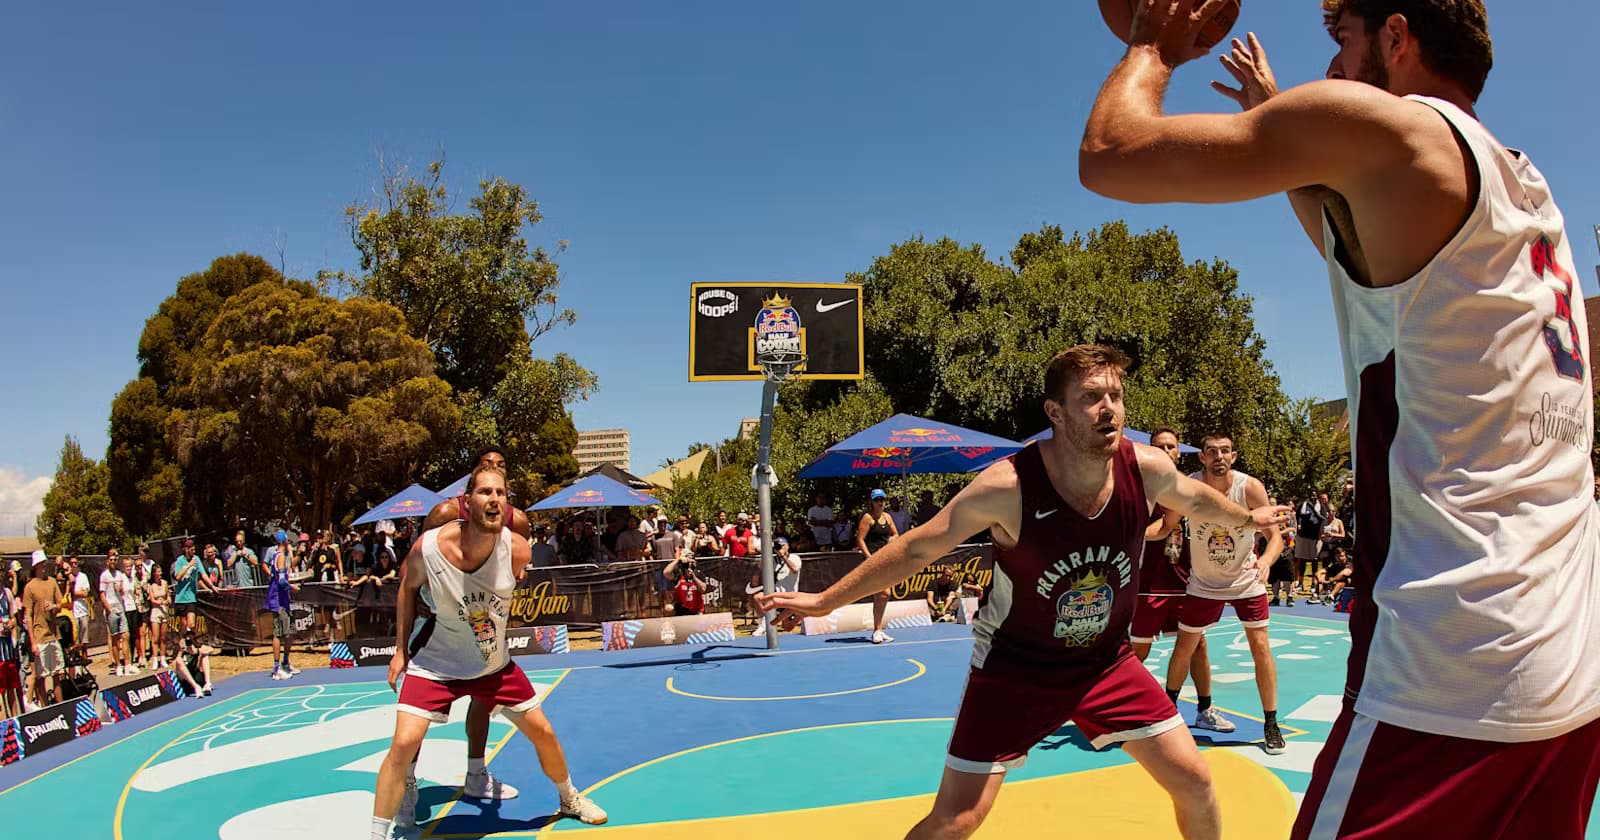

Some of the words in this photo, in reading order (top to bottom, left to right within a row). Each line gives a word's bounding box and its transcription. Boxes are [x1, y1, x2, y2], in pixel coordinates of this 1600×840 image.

[699, 289, 726, 301] HOUSE
[760, 323, 778, 333] Red
[779, 322, 797, 332] Bull
[1036, 546, 1110, 600] PRAHRAN
[1111, 550, 1132, 589] PARK
[523, 581, 571, 623] Jam
[1062, 604, 1087, 617] Red
[359, 645, 398, 660] SPALDIN
[24, 713, 70, 744] SPALDING
